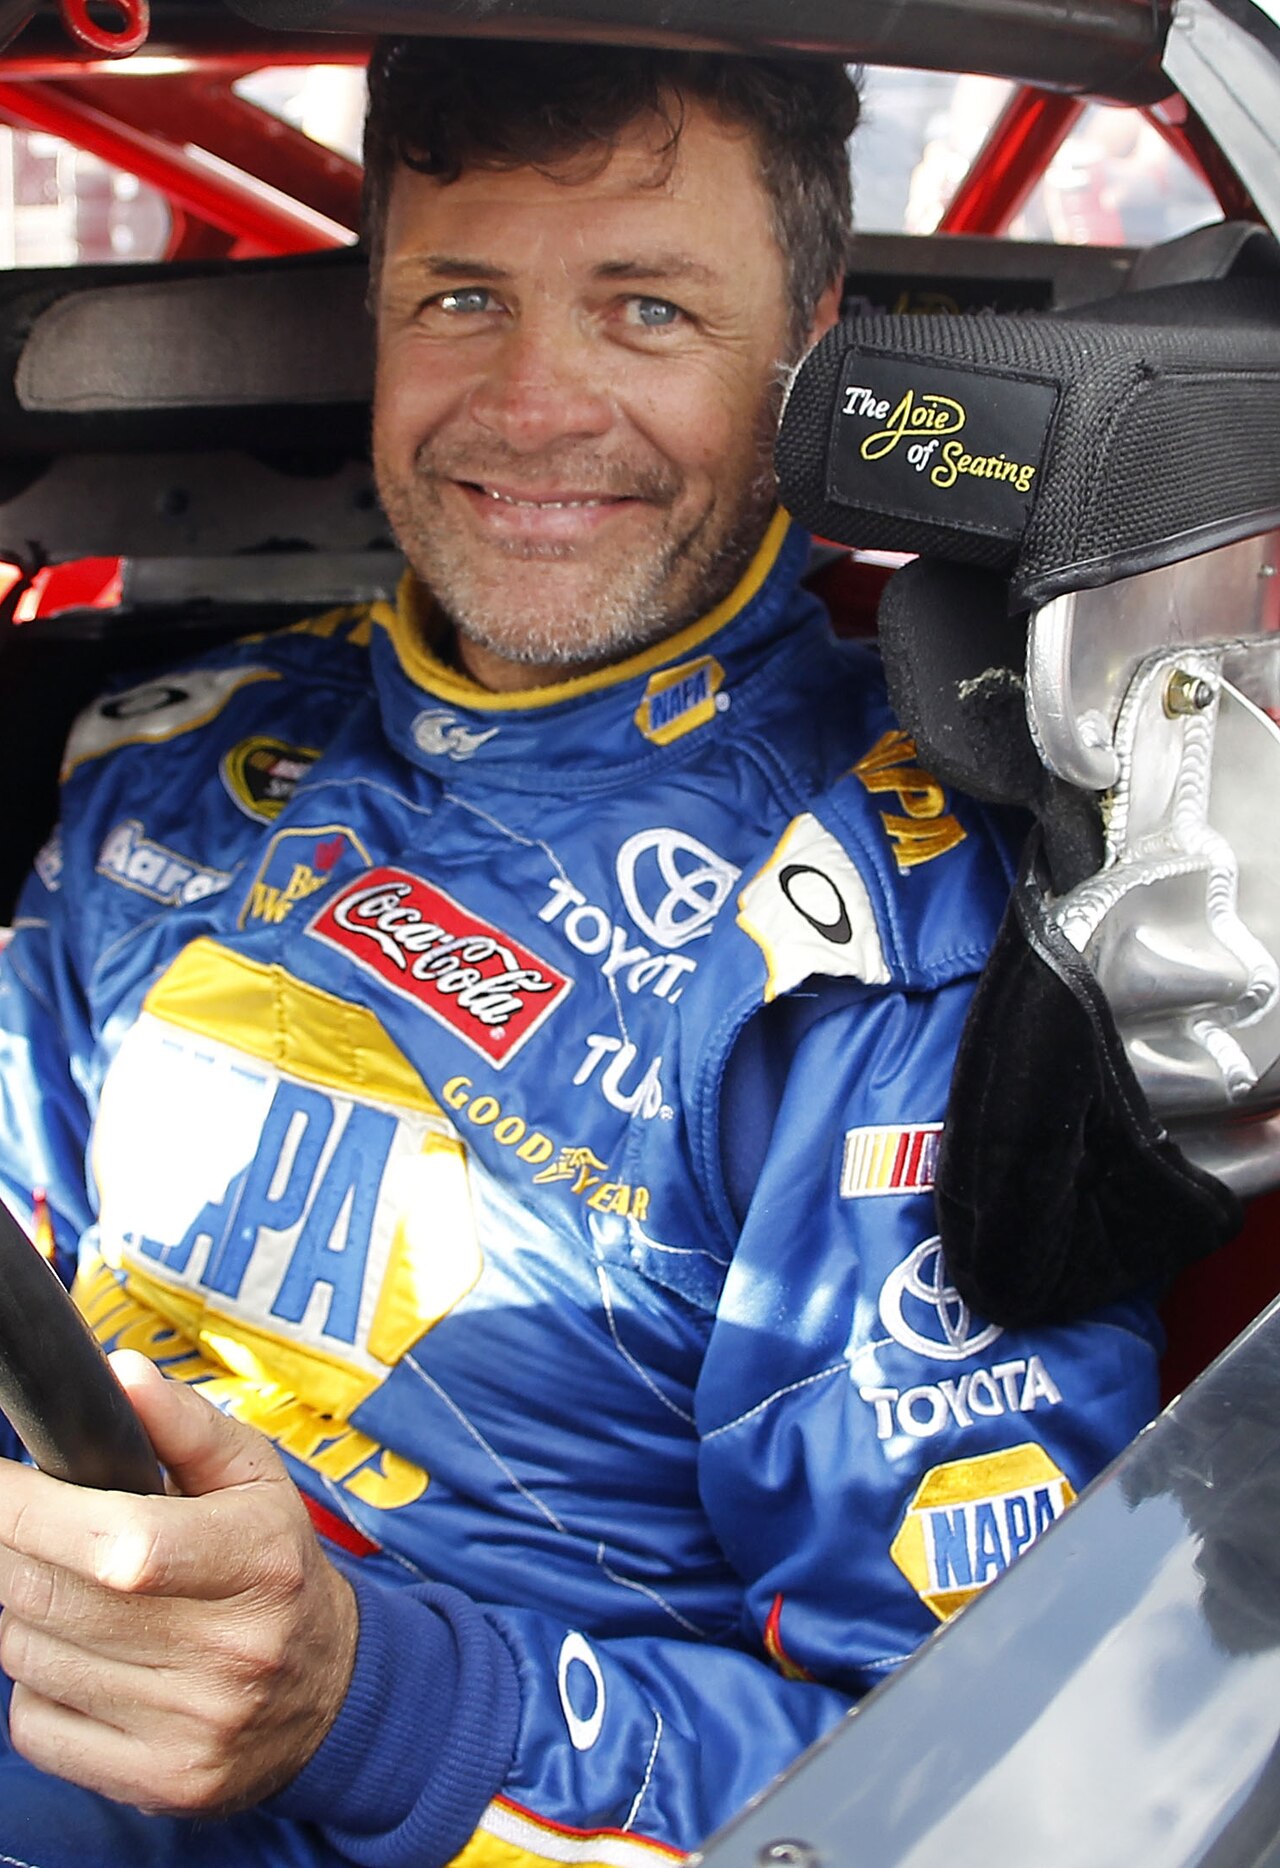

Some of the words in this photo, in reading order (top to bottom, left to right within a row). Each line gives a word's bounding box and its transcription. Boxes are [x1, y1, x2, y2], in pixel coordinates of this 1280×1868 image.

[842, 386, 891, 419] The
[860, 389, 966, 460] Joie
[907, 439, 939, 471] of
[931, 441, 1036, 492] Seating
[650, 669, 707, 730] NAPA
[333, 881, 554, 1025] Coca-Cola
[537, 877, 698, 1004] TOYOT
[858, 1354, 1063, 1440] TOYOTA
